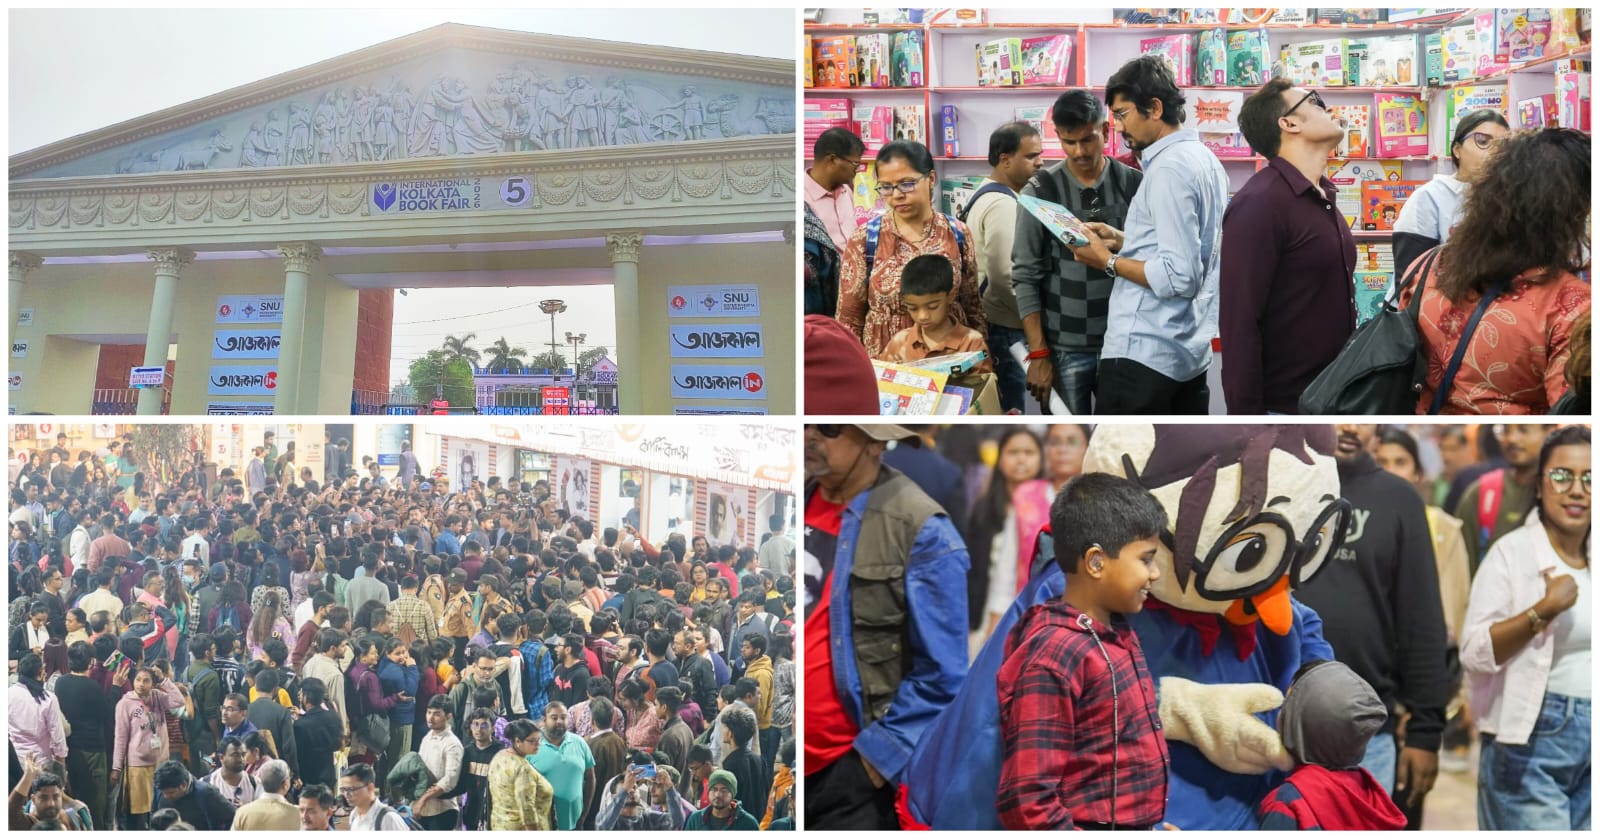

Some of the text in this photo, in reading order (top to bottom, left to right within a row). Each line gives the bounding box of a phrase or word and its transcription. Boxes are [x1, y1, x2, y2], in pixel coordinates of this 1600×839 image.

[400, 178, 471, 188] INTERNATIONAL
[400, 187, 461, 200] KOLKATA
[506, 178, 525, 203] 5
[400, 198, 471, 211] BOOK FAIR
[723, 293, 749, 303] SNU
[260, 302, 281, 311] SNU
[672, 331, 760, 350] আজকাল
[210, 374, 263, 388] আজকাল
[673, 375, 742, 390] আজকাল
